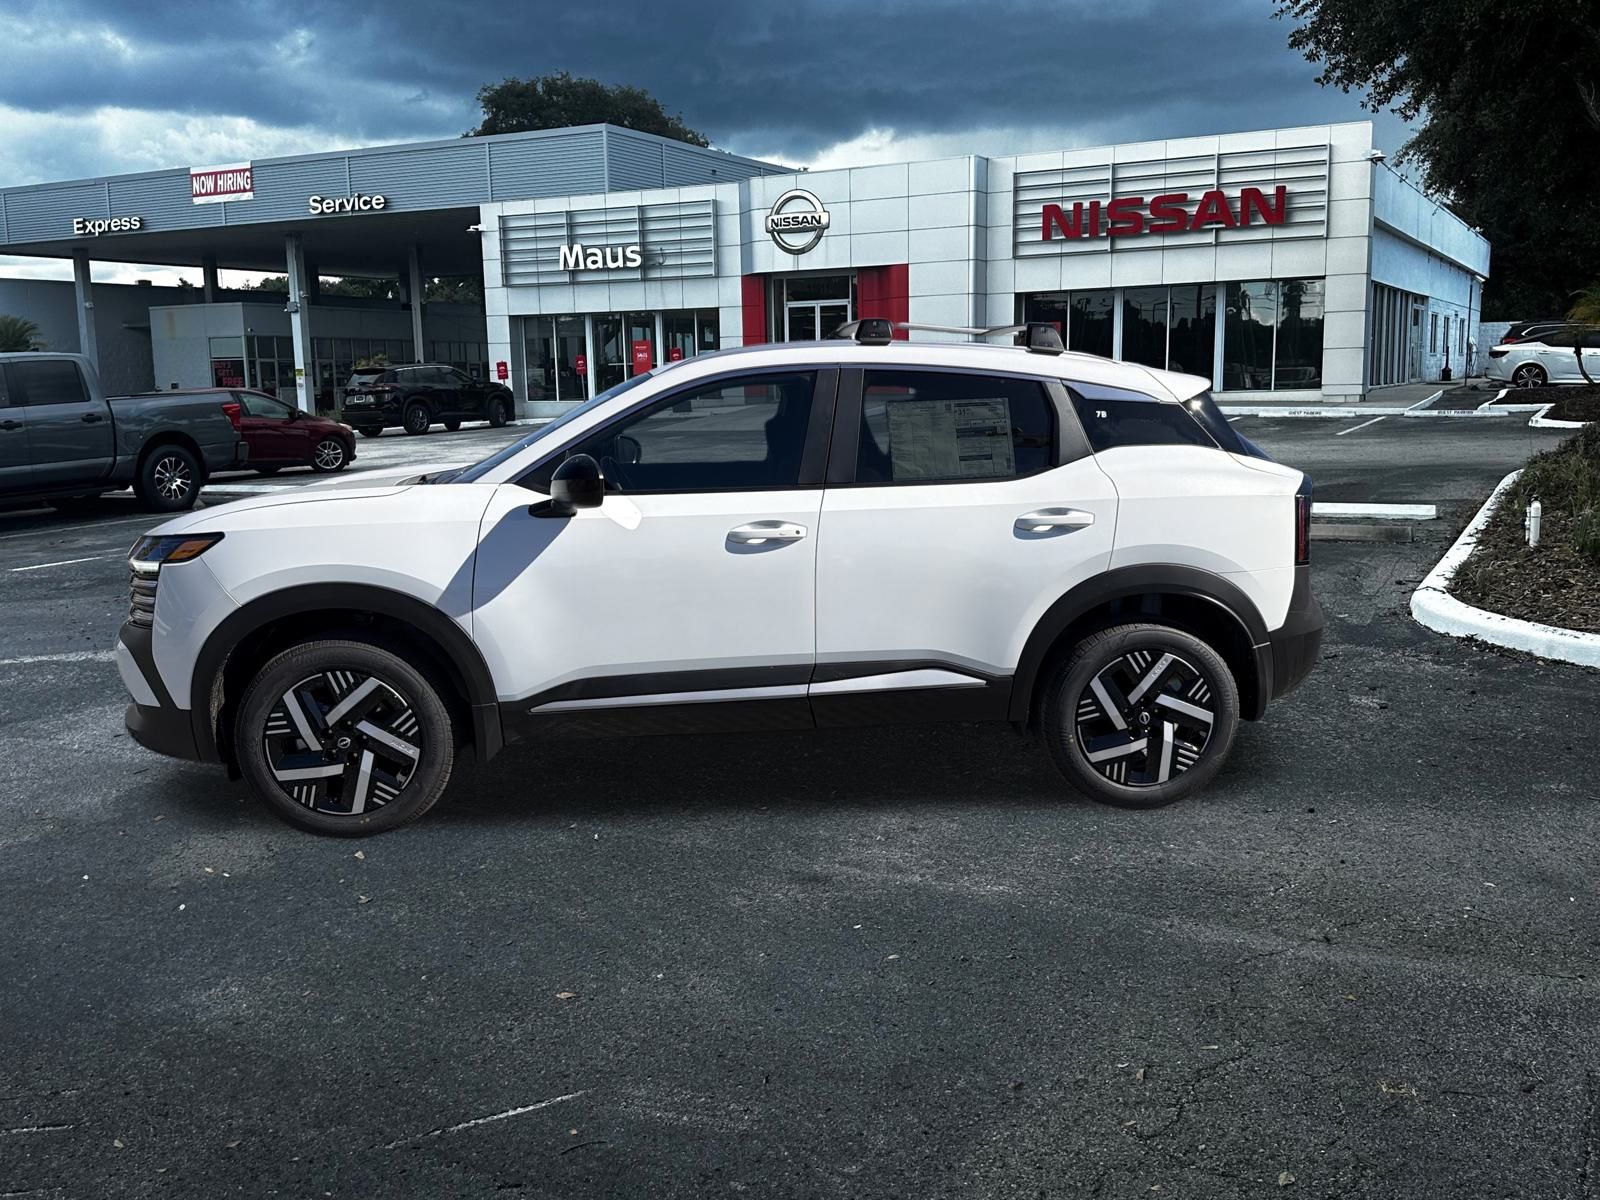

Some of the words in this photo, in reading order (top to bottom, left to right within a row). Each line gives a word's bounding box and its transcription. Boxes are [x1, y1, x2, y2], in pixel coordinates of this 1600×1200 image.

[193, 174, 215, 194] NOW
[217, 171, 250, 192] HIRING
[309, 193, 385, 214] Service
[1042, 185, 1287, 241] NISSAN
[73, 216, 141, 236] Express
[770, 215, 822, 229] NISSAN
[559, 243, 642, 270] Maus
